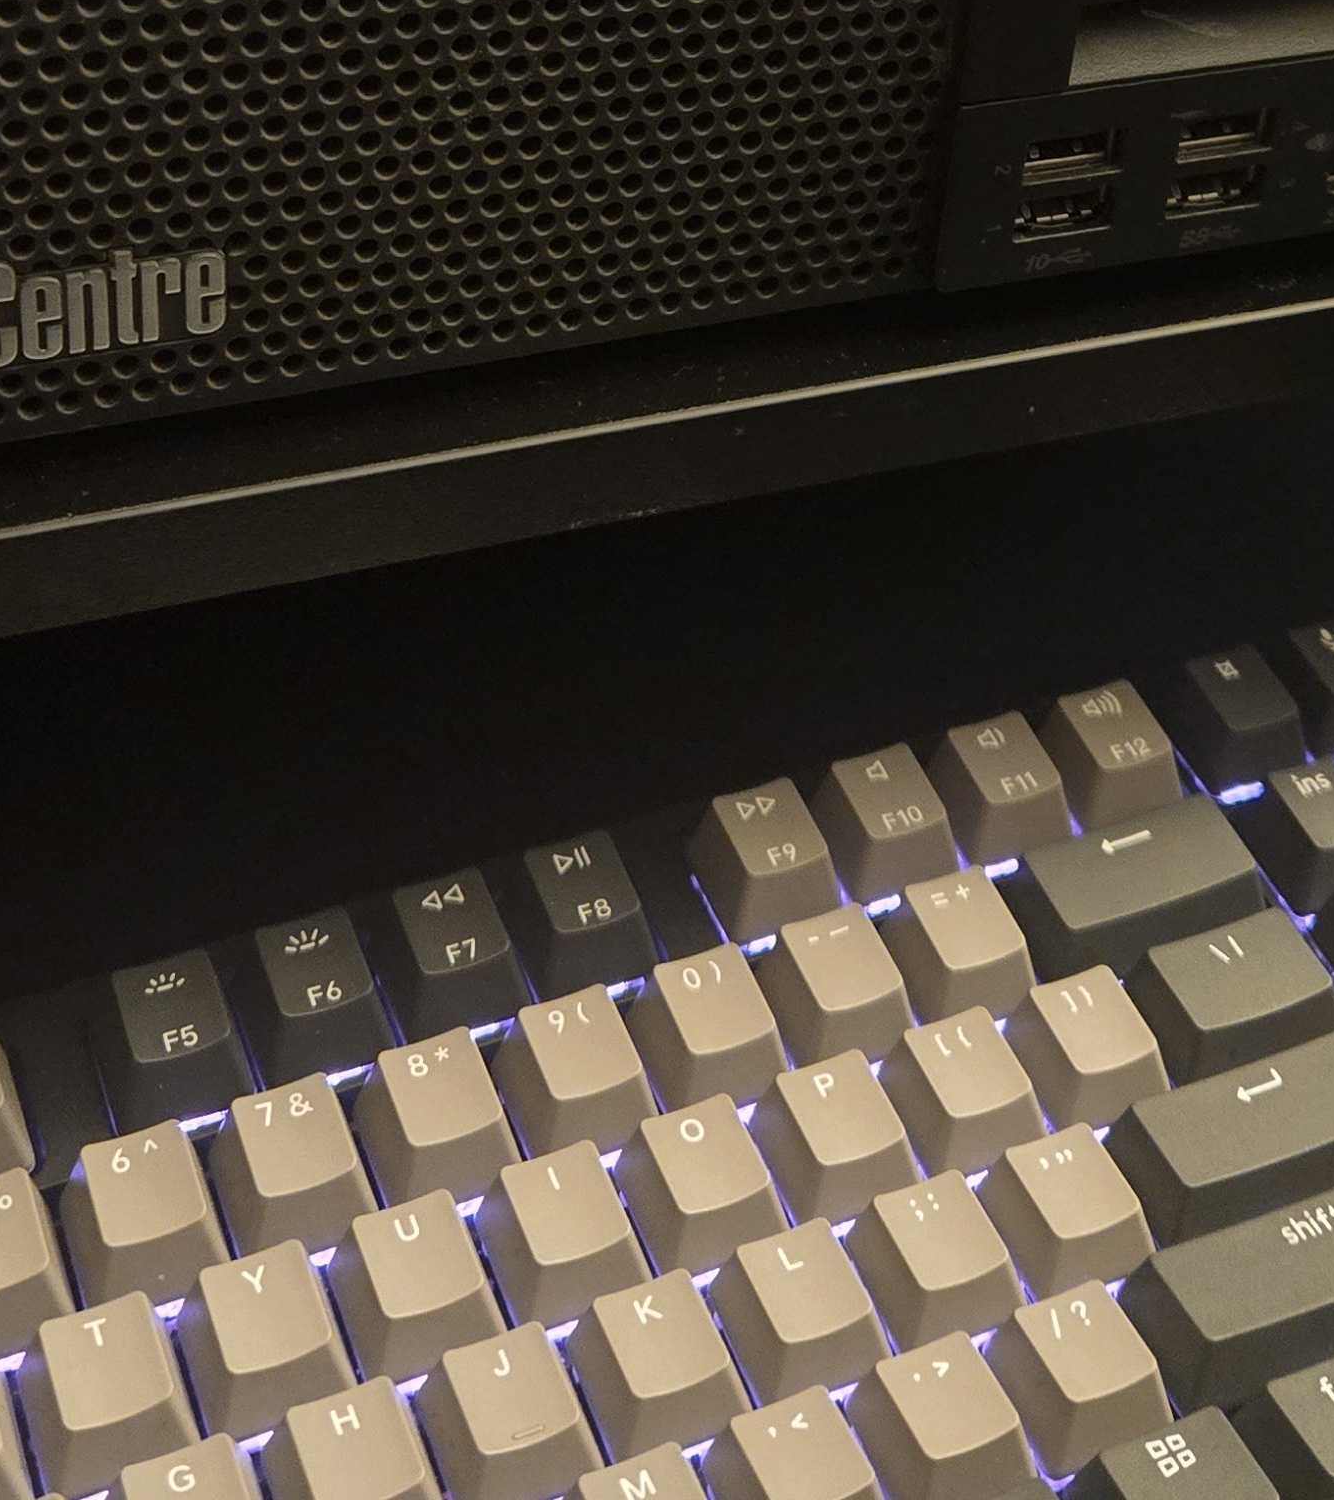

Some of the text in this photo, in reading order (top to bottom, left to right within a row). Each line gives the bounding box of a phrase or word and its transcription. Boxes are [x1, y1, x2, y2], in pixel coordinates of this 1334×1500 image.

[1110, 738, 1150, 762] F12
[1001, 772, 1037, 796] F11
[1291, 772, 1332, 797] ins
[881, 806, 923, 831] F10
[767, 844, 795, 866] F9
[577, 898, 611, 924] F8
[445, 938, 477, 964] F7
[683, 968, 701, 989] 0
[307, 980, 342, 1006] F6
[548, 1010, 565, 1034] 9
[163, 1024, 199, 1052] F5
[407, 1054, 429, 1077] 8
[814, 1073, 834, 1097] P
[255, 1102, 273, 1127] 7
[680, 1118, 705, 1142] O
[111, 1148, 131, 1173] 6
[547, 1166, 561, 1190] I
[393, 1214, 419, 1242] U
[777, 1248, 803, 1270] L
[241, 1264, 265, 1294] Y
[633, 1296, 663, 1324] K
[83, 1318, 107, 1346] T
[493, 1350, 509, 1376] J
[330, 1404, 361, 1436] H
[168, 1464, 195, 1492] G
[619, 1470, 657, 1500] M
